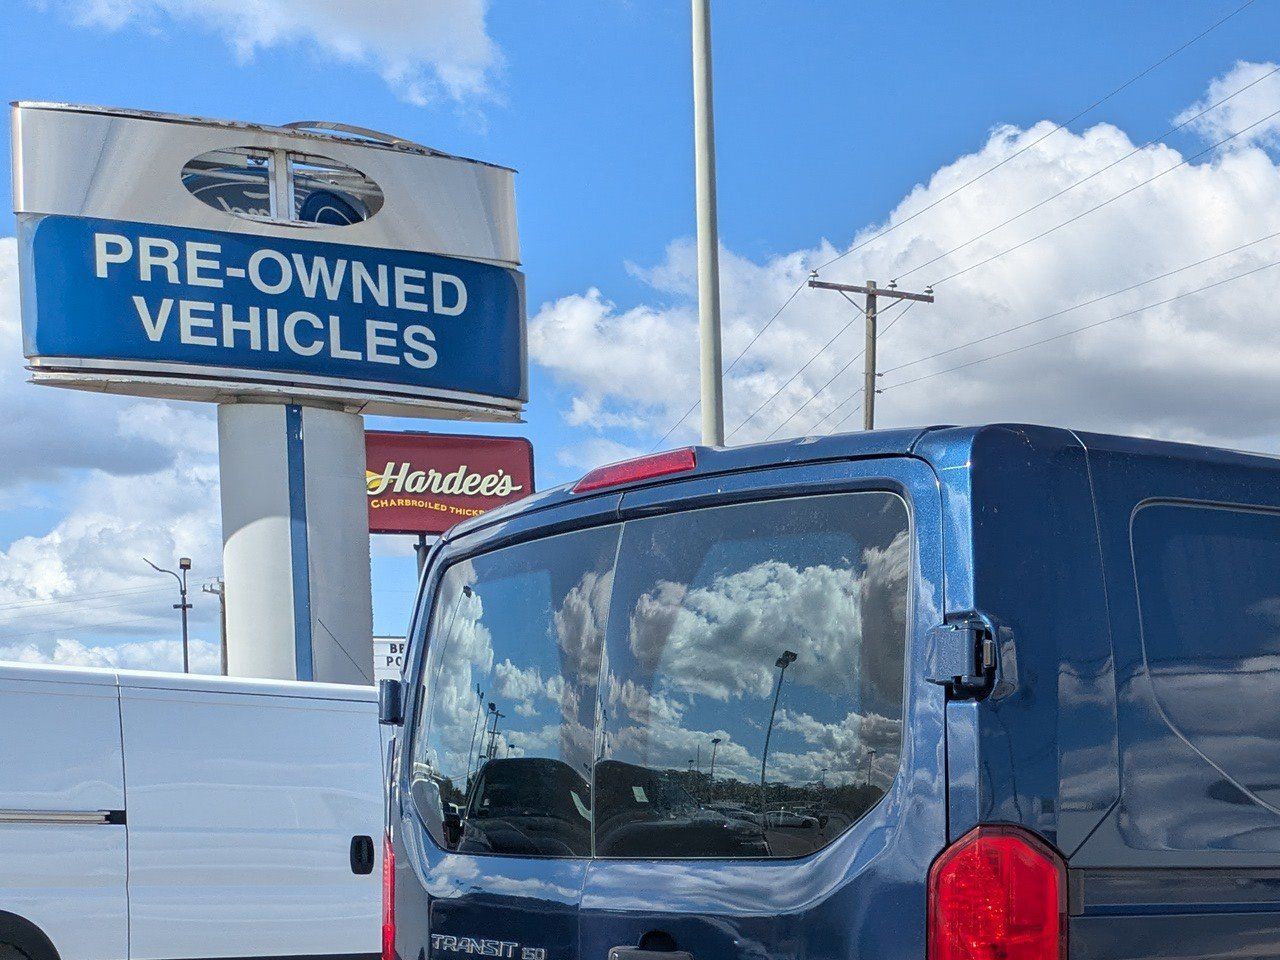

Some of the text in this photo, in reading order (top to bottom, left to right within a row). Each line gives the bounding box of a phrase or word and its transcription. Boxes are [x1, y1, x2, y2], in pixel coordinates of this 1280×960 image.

[95, 233, 468, 316] PRE-OWNED
[132, 296, 438, 369] VEHICLES
[367, 462, 523, 496] Hardee's
[371, 499, 447, 512] CHARBROILED
[431, 933, 546, 960] TRANSIT 150
